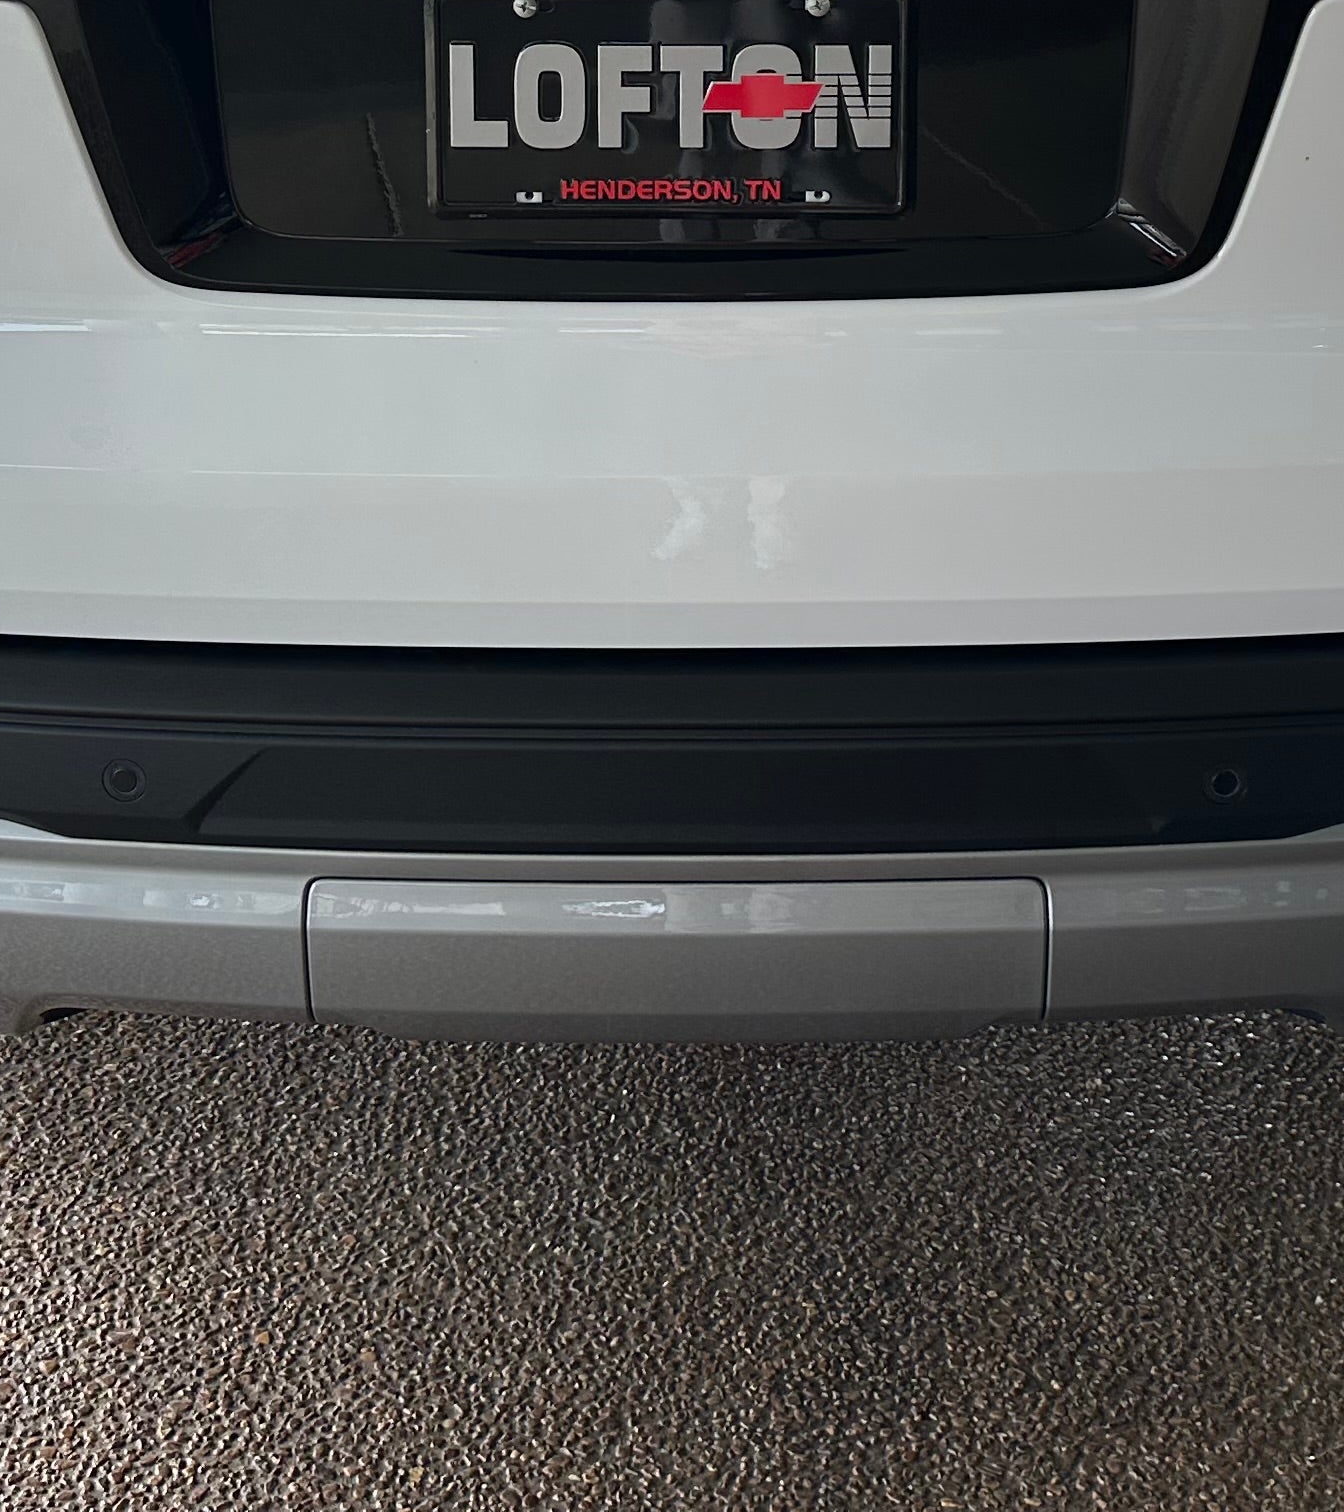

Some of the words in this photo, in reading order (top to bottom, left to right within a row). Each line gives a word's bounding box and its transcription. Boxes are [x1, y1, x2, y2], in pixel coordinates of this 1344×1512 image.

[449, 43, 892, 149] LOFTON
[560, 179, 739, 204] HENDERSON,
[744, 179, 782, 201] TN
